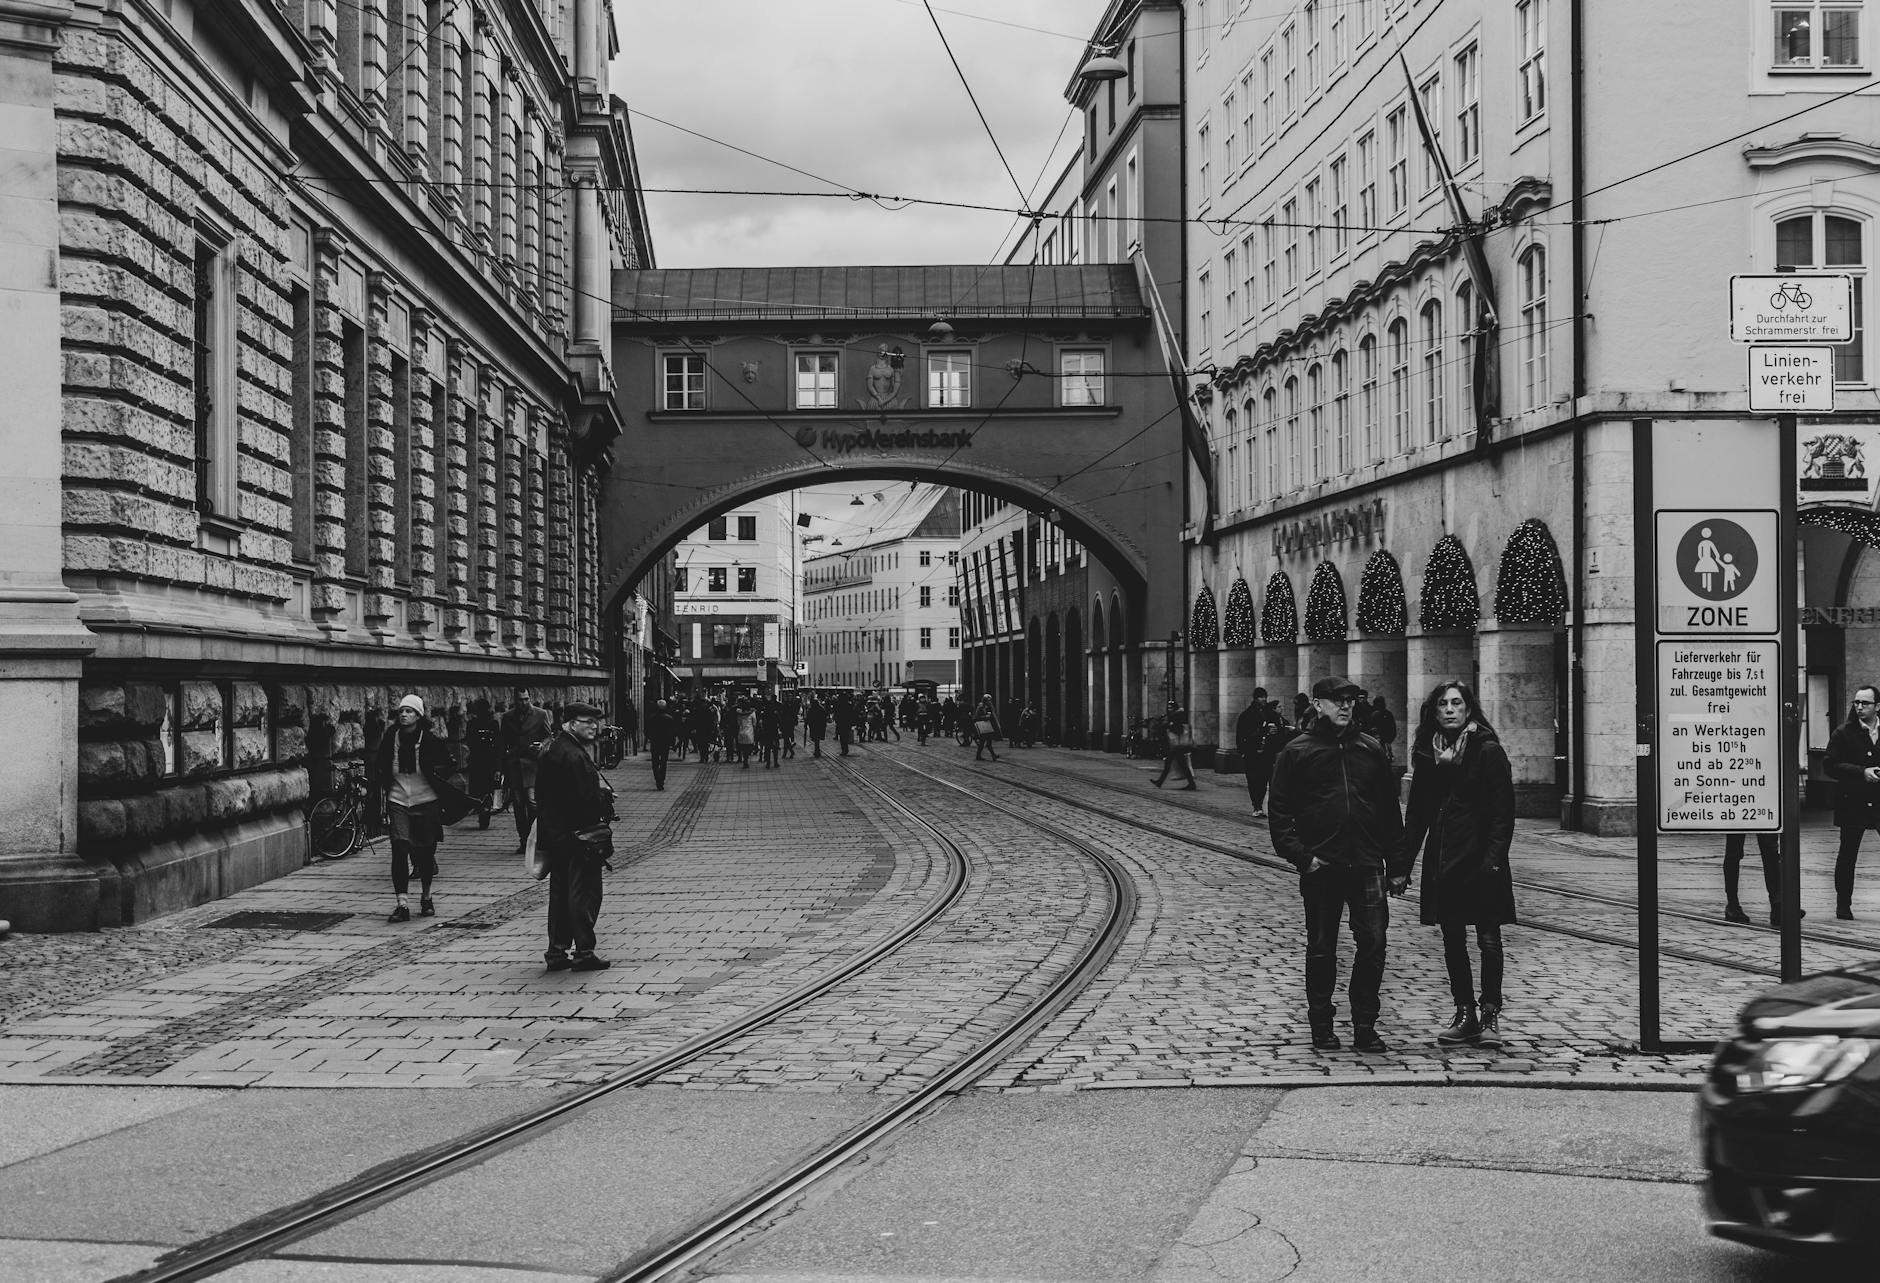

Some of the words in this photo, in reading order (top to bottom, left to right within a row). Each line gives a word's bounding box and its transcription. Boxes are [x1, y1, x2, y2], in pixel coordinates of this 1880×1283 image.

[1756, 313, 1809, 324] Durchfahrt
[1812, 315, 1828, 324] zur
[1822, 325, 1839, 335] frei
[1764, 353, 1818, 367] Linien-
[1761, 371, 1822, 385] verkehr
[1779, 389, 1806, 403] frei
[822, 428, 972, 454] HypoVereinsbank
[1687, 607, 1749, 626] ZONE
[1674, 651, 1742, 663] Lieferverkehr
[1747, 650, 1762, 663] für
[1672, 668, 1722, 682] Fahrzeuge
[1727, 668, 1741, 680] bis
[1670, 684, 1688, 697] zul.
[1692, 684, 1767, 699] Gesamtgewicht
[1708, 701, 1730, 713] frei
[1672, 727, 1688, 737] an
[1694, 724, 1766, 739] Werktagen
[1692, 741, 1711, 753] bis
[1677, 758, 1701, 770] und
[1708, 758, 1723, 770] ab
[1674, 777, 1690, 787] an
[1696, 775, 1736, 787] Sonn-
[1742, 775, 1765, 787] und
[1684, 791, 1755, 806] Feiertagen
[1666, 808, 1714, 824] jeweils
[1720, 808, 1736, 820] ab
